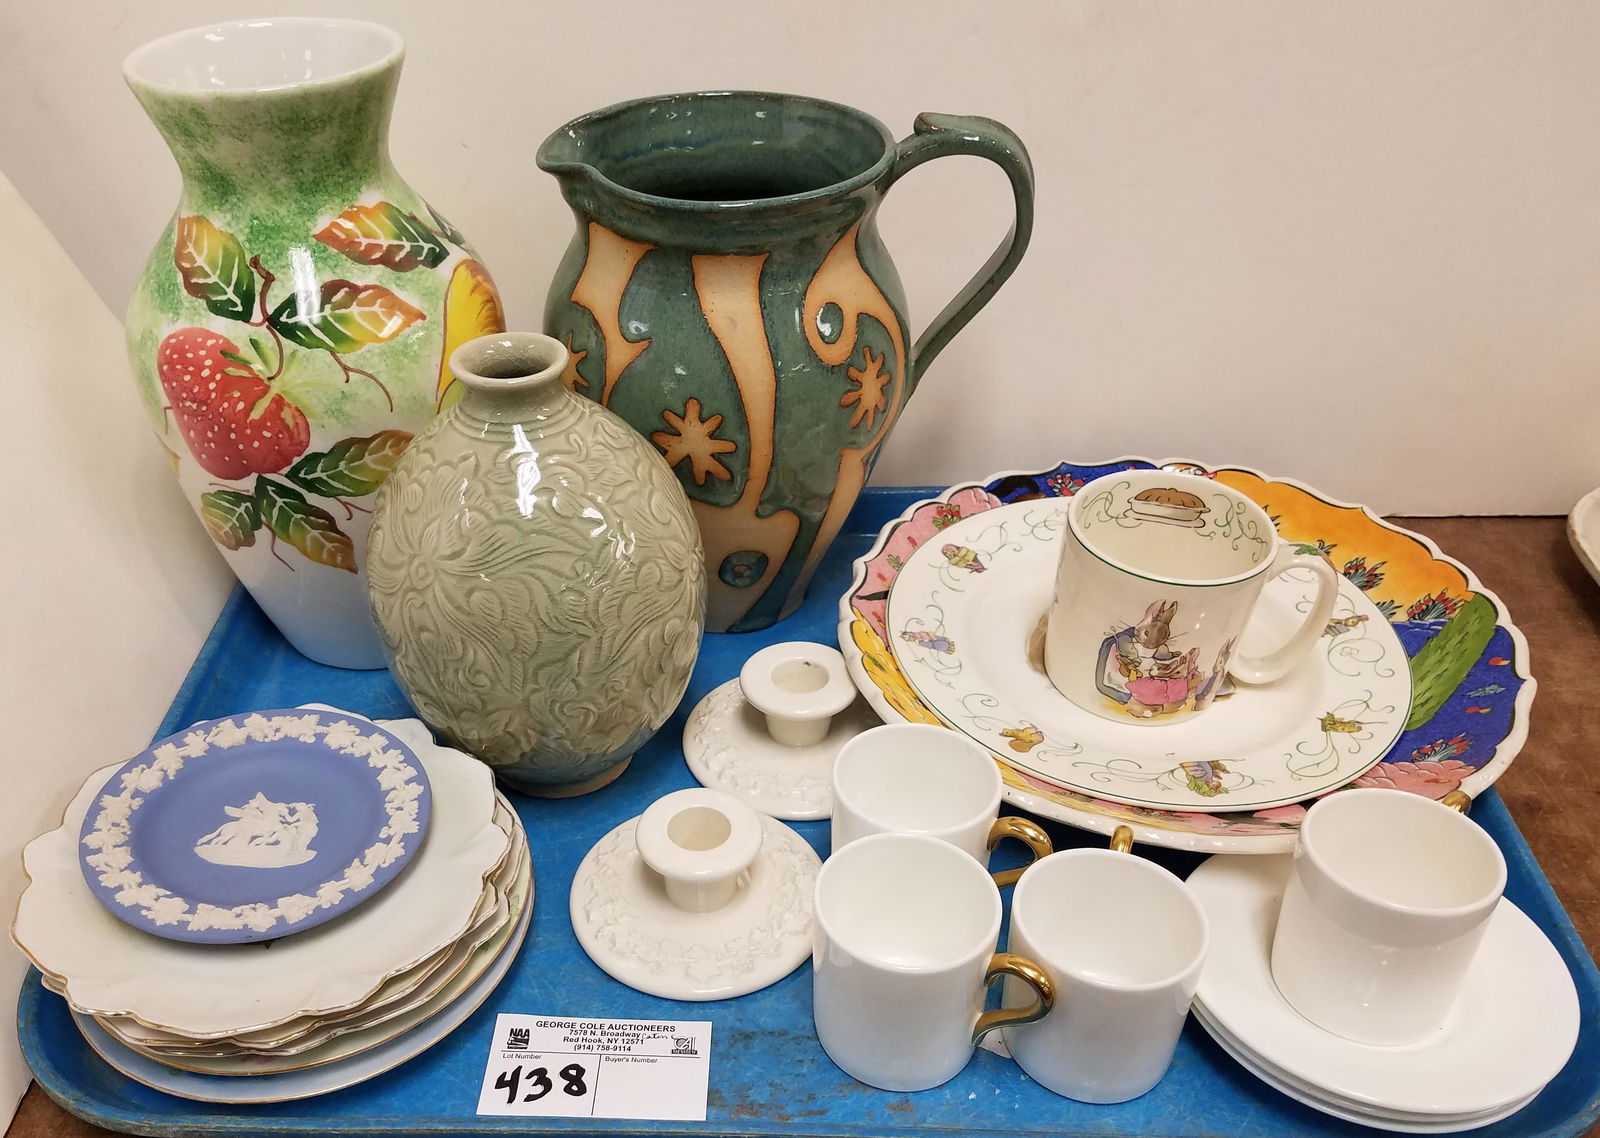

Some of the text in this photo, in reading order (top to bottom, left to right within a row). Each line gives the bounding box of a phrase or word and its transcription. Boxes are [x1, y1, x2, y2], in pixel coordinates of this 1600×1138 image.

[536, 1020, 576, 1028] GEORGE
[608, 1024, 676, 1032] AUCTIONEERS
[510, 1028, 530, 1038] NAA
[494, 1063, 588, 1104] 438
